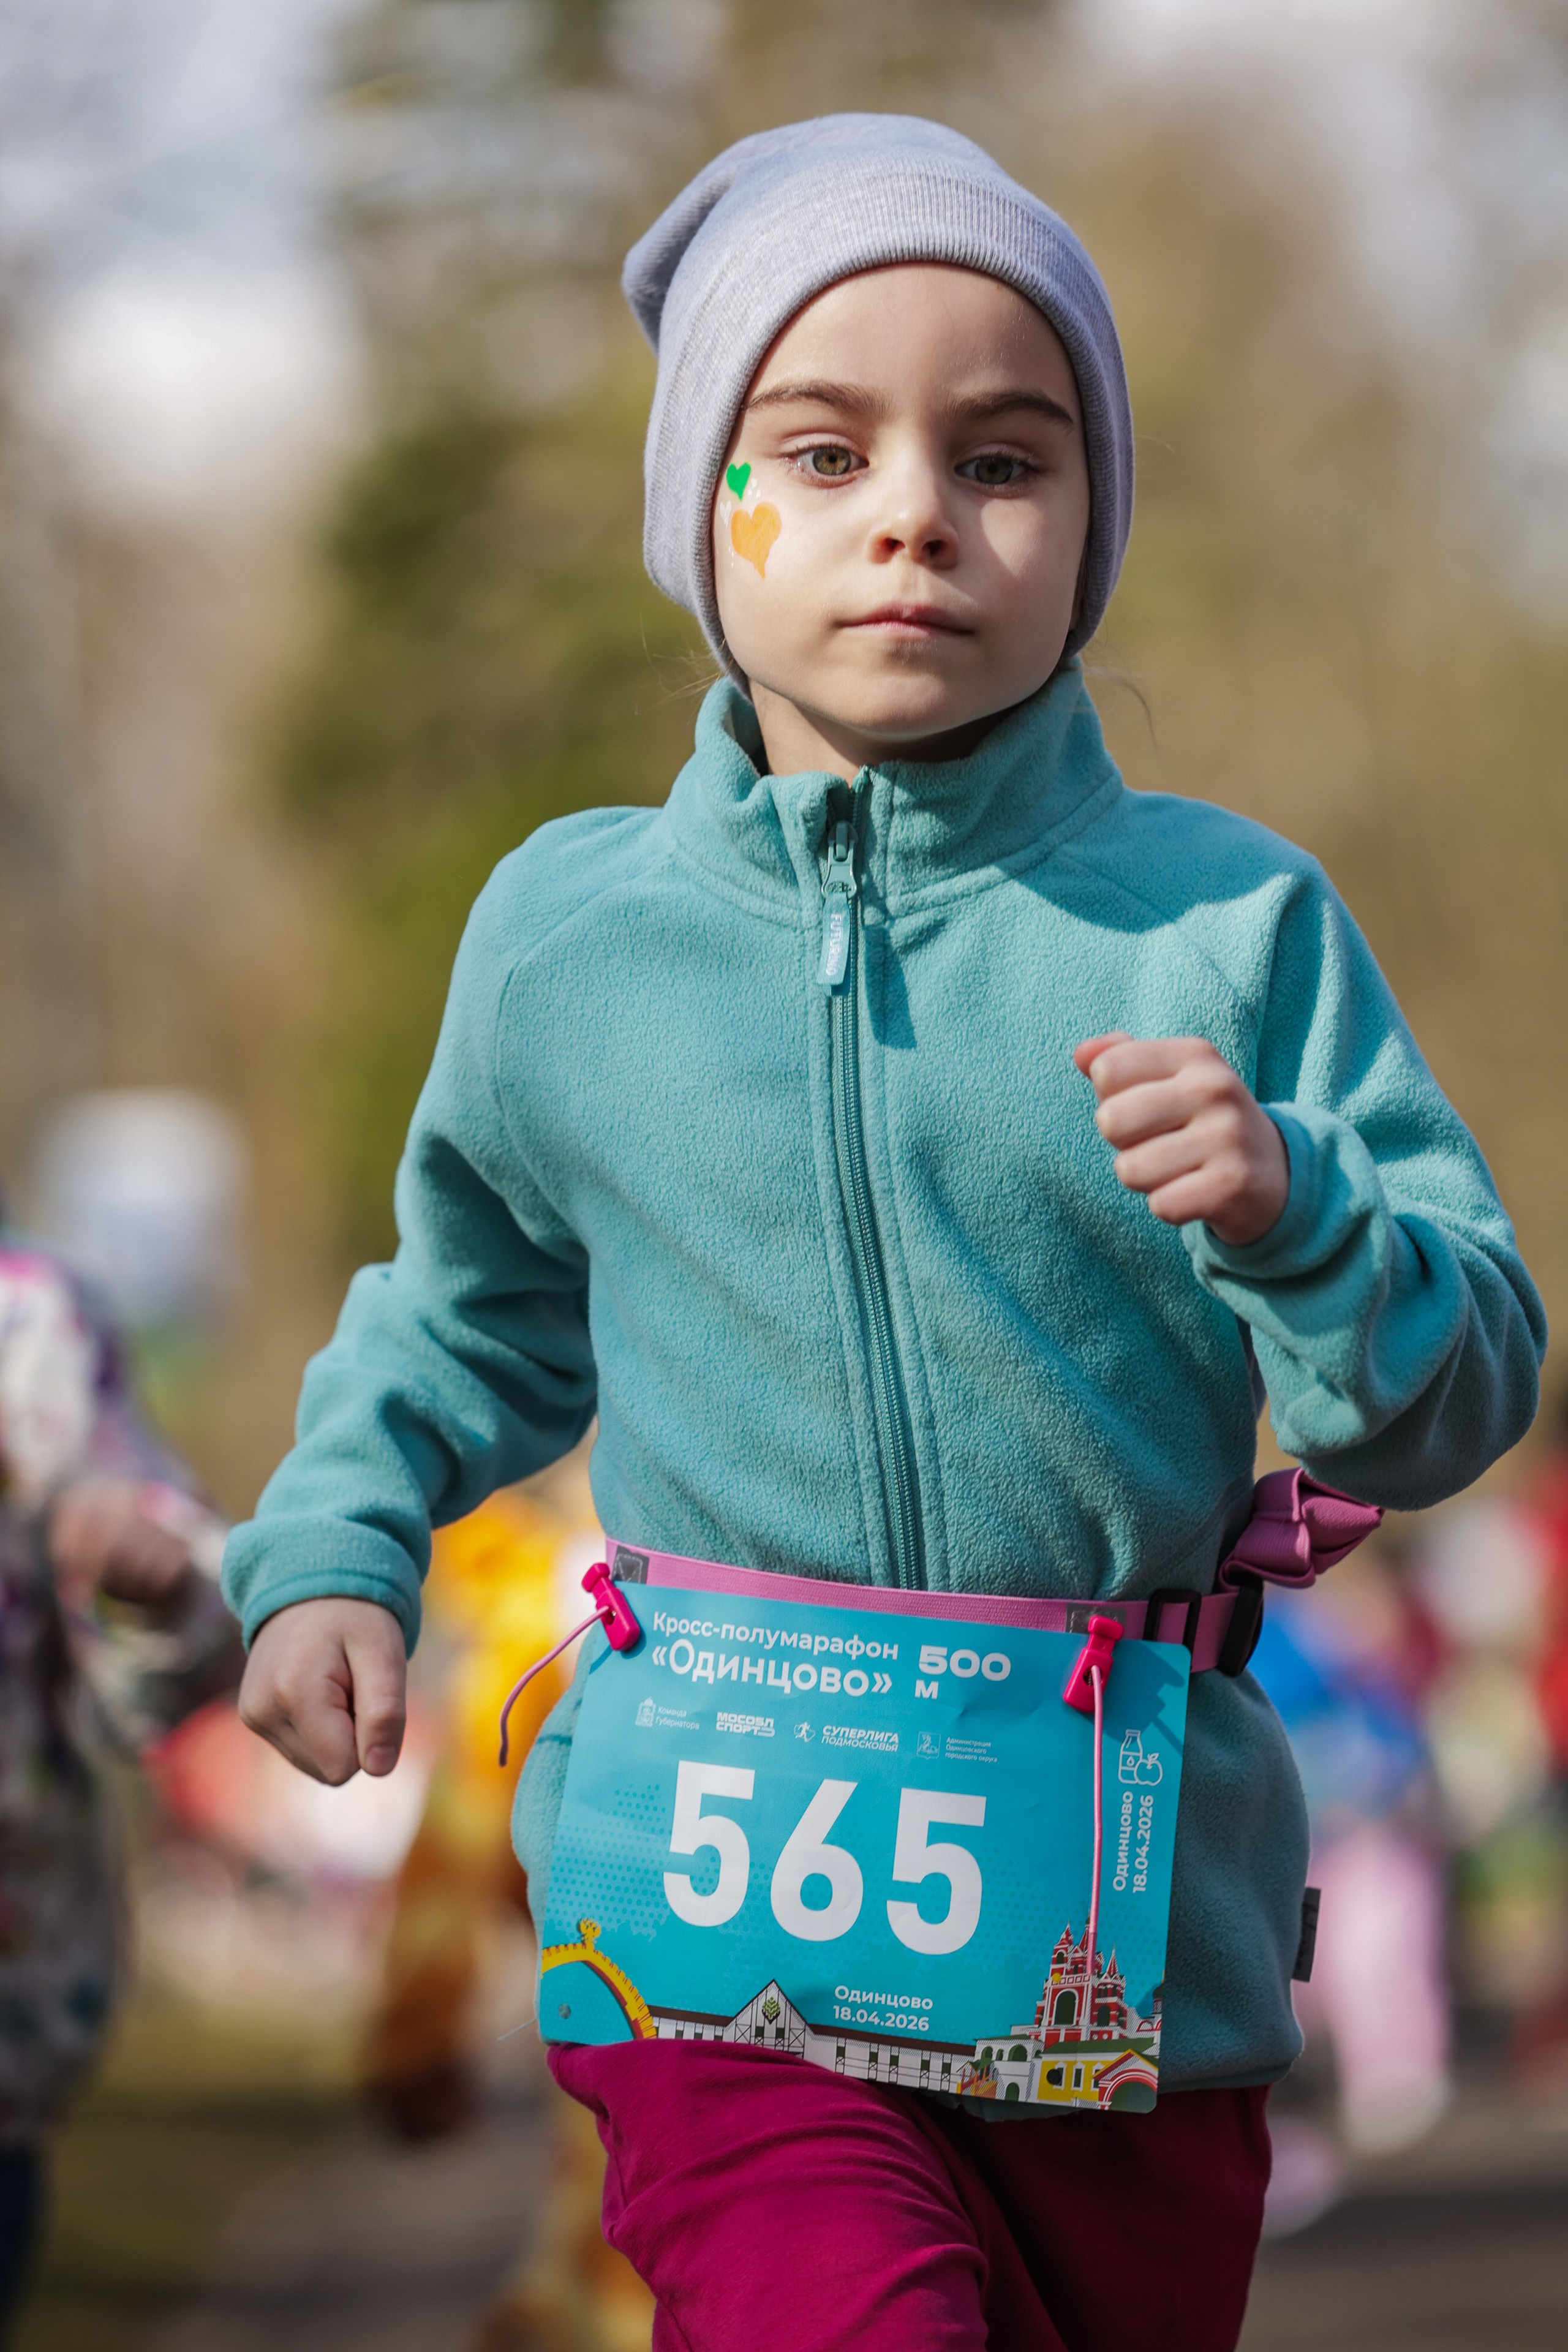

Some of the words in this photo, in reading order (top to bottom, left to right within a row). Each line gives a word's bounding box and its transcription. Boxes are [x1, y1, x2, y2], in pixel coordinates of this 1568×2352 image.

[653, 1611, 899, 1660] Кросс-полумарафон
[652, 1638, 893, 1697] «Одинцово»
[919, 1645, 1011, 1681] 500
[658, 1706, 687, 1718] Команда
[717, 1711, 775, 1728] МОСОБЛ
[655, 1716, 700, 1731] Губернатора
[716, 1721, 764, 1736] СПОРТ
[821, 1735, 899, 1752] ПОДМОСКОВЬЯ
[823, 1725, 899, 1744] СУПЕРЛИГА
[946, 1736, 992, 1747] Администрация
[945, 1752, 978, 1761] городского
[946, 1744, 987, 1755] Одинцовского
[1112, 1790, 1133, 1891] Одинцово
[1133, 1794, 1154, 1894] 18.04.2026
[663, 1760, 987, 1955] 565
[834, 1985, 933, 2010] Одинцово
[833, 2005, 929, 2031] 18.04.2026
